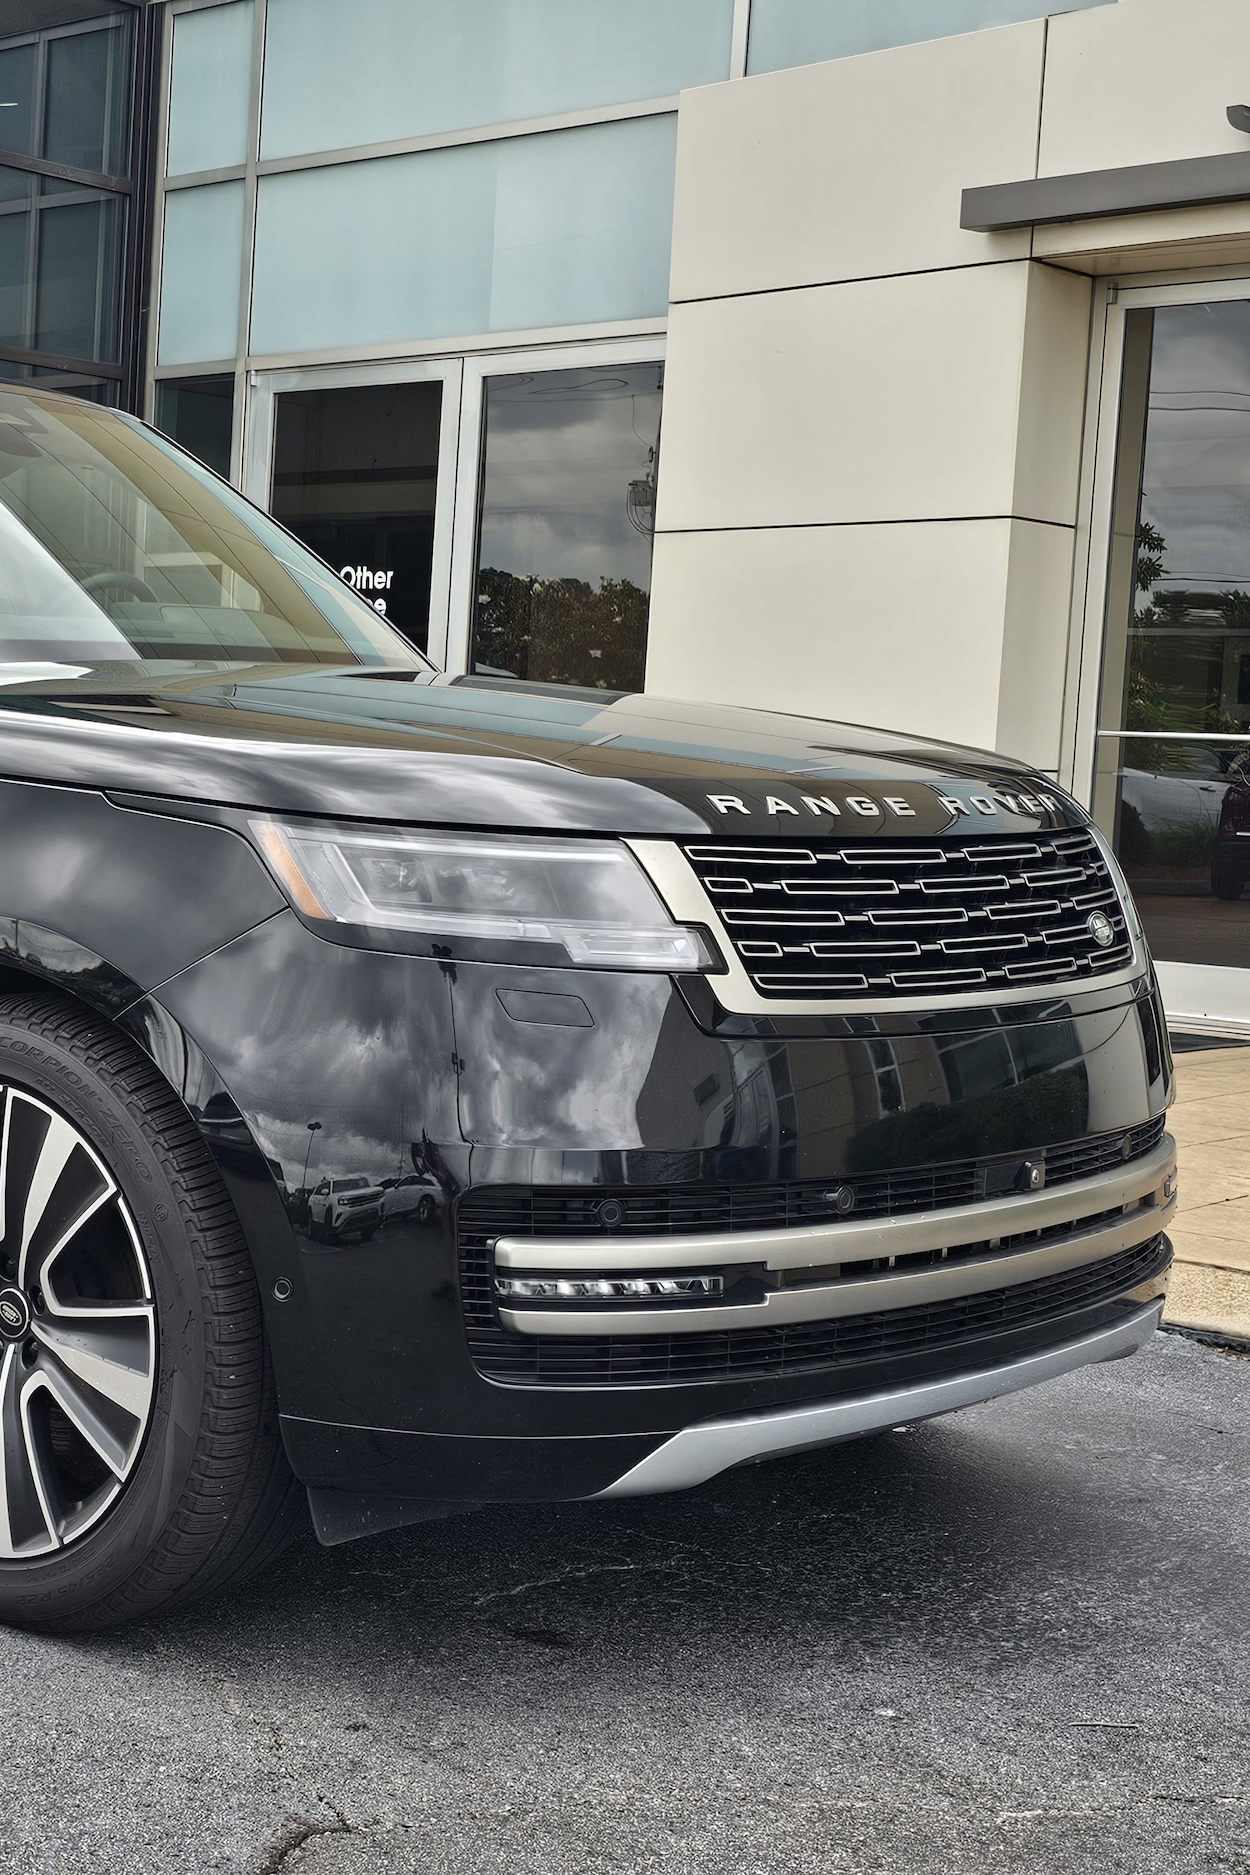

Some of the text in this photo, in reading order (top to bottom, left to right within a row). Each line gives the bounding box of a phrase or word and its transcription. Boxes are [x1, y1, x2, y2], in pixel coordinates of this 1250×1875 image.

[340, 566, 393, 589] Other
[706, 794, 1063, 816] RANGE ROVER
